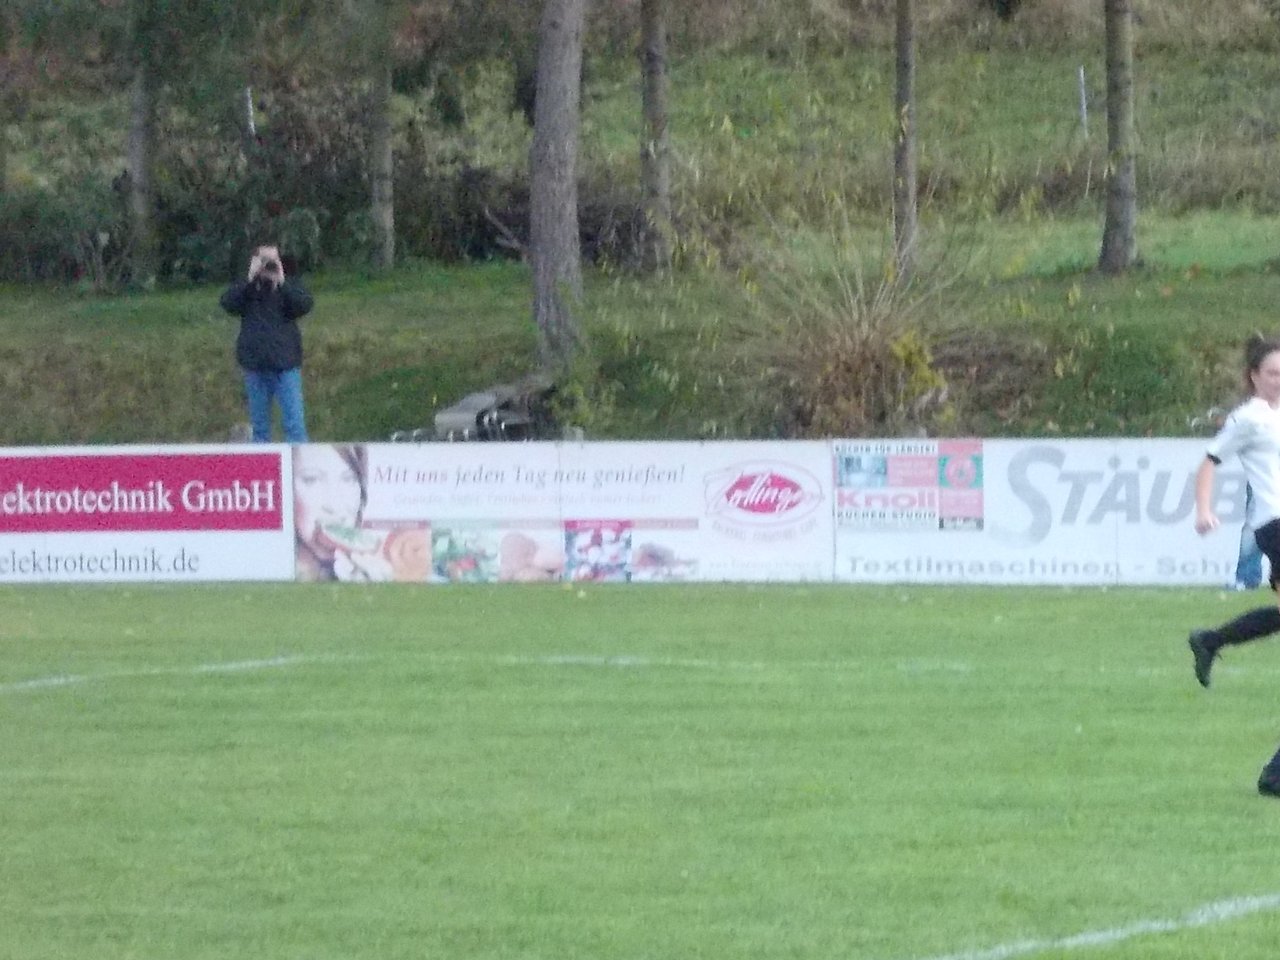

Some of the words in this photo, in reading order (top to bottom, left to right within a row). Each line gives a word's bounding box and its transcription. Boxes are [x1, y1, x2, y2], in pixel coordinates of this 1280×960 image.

[373, 464, 408, 484] Mit
[415, 469, 448, 484] uns
[453, 464, 506, 489] jeden
[512, 465, 547, 490] Tag
[553, 469, 587, 484] neu
[182, 479, 275, 513] GmbH
[837, 489, 936, 510] Knoll
[987, 445, 1248, 550] STÄUB
[0, 547, 200, 575] elektrotechnik.de
[848, 555, 1121, 578] Textilmaschinen
